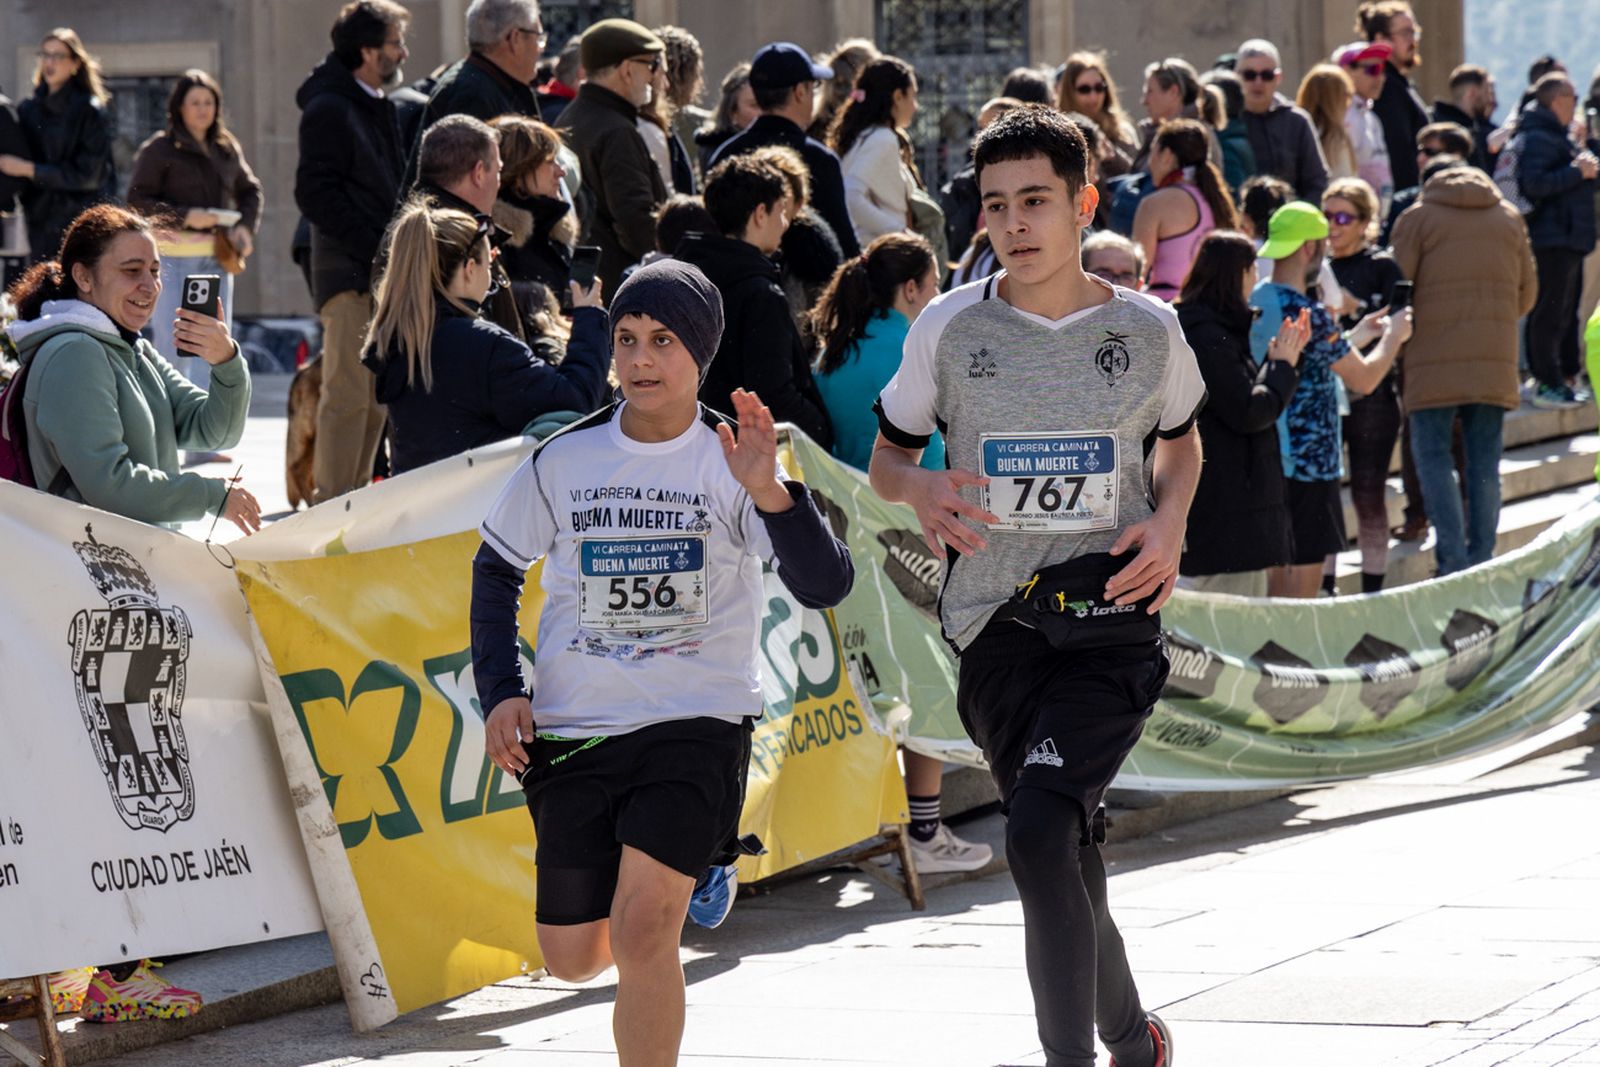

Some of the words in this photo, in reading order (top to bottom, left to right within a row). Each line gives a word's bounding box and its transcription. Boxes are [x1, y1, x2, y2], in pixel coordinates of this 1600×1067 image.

[997, 444, 1006, 453] VI
[1008, 443, 1050, 453] CARRERA
[1052, 441, 1100, 452] CAMINATA
[997, 457, 1033, 472] BUENA
[1035, 456, 1079, 471] MUERTE
[569, 489, 581, 502] VI
[584, 487, 642, 501] CARRERA
[646, 488, 708, 506] CAMINAT
[1013, 476, 1087, 512] 767
[571, 507, 612, 532] BUENA
[619, 507, 684, 530] MUERTE
[602, 545, 642, 554] CARRERA
[644, 541, 689, 553] CAMINATA
[592, 558, 626, 572] BUENA
[628, 555, 670, 571] MUERTE
[608, 575, 676, 611] 556
[9, 816, 24, 845] de
[91, 854, 169, 892] CIUDAD
[170, 851, 200, 884] DE
[203, 838, 252, 879] JAÉN
